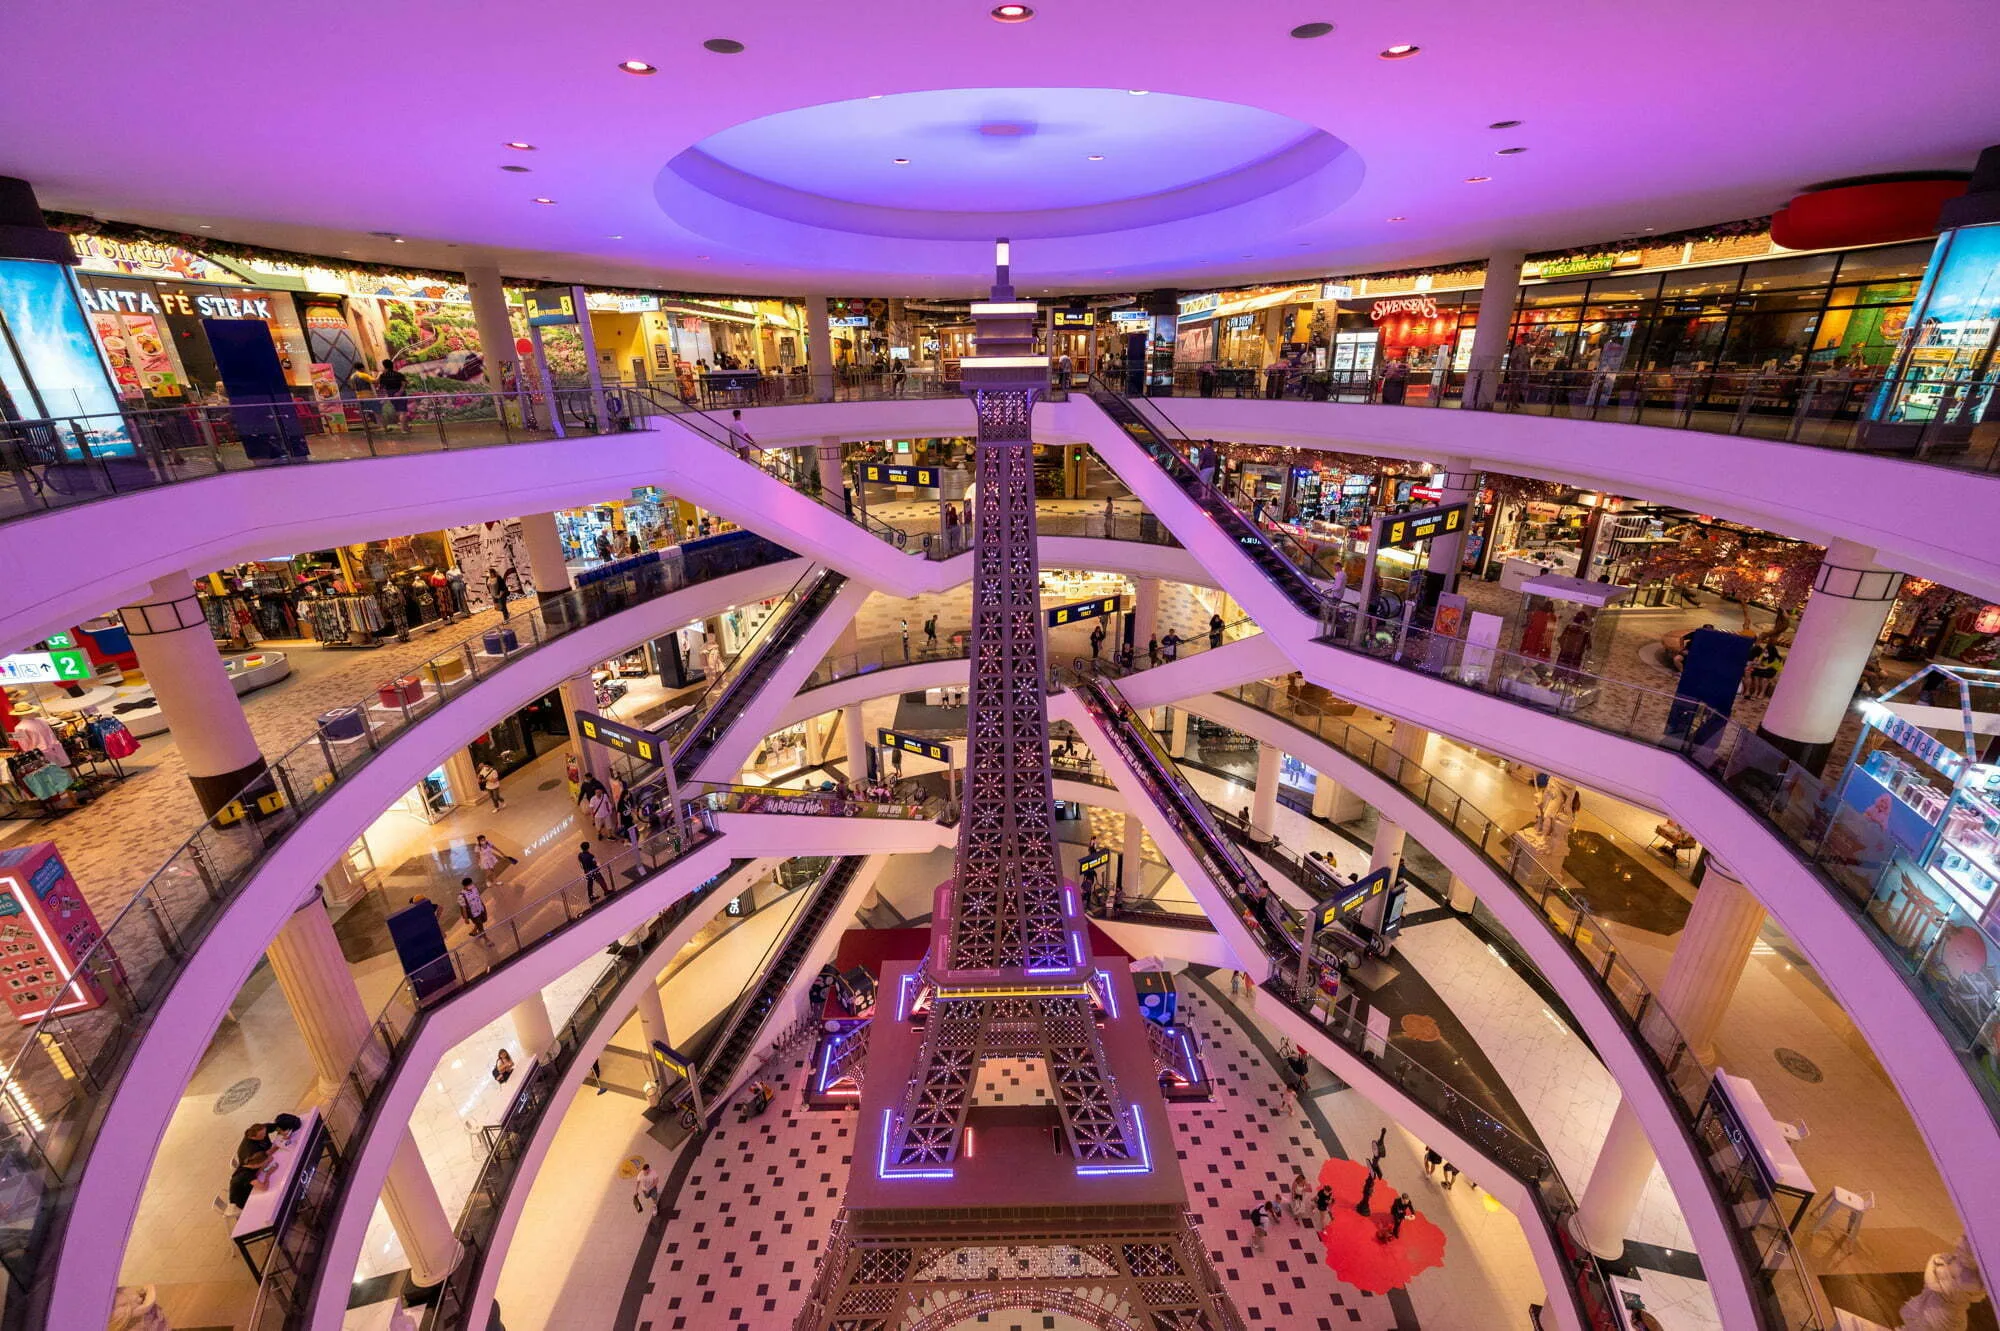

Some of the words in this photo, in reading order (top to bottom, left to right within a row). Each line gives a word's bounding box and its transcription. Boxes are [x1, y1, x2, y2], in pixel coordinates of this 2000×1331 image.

[1564, 260, 1605, 273] CANNERY
[80, 287, 160, 314] ANTA
[160, 289, 194, 316] FÉ
[196, 295, 272, 319] STEAK
[1449, 513, 1456, 526] 2
[47, 635, 69, 646] JR
[60, 656, 80, 675] 2
